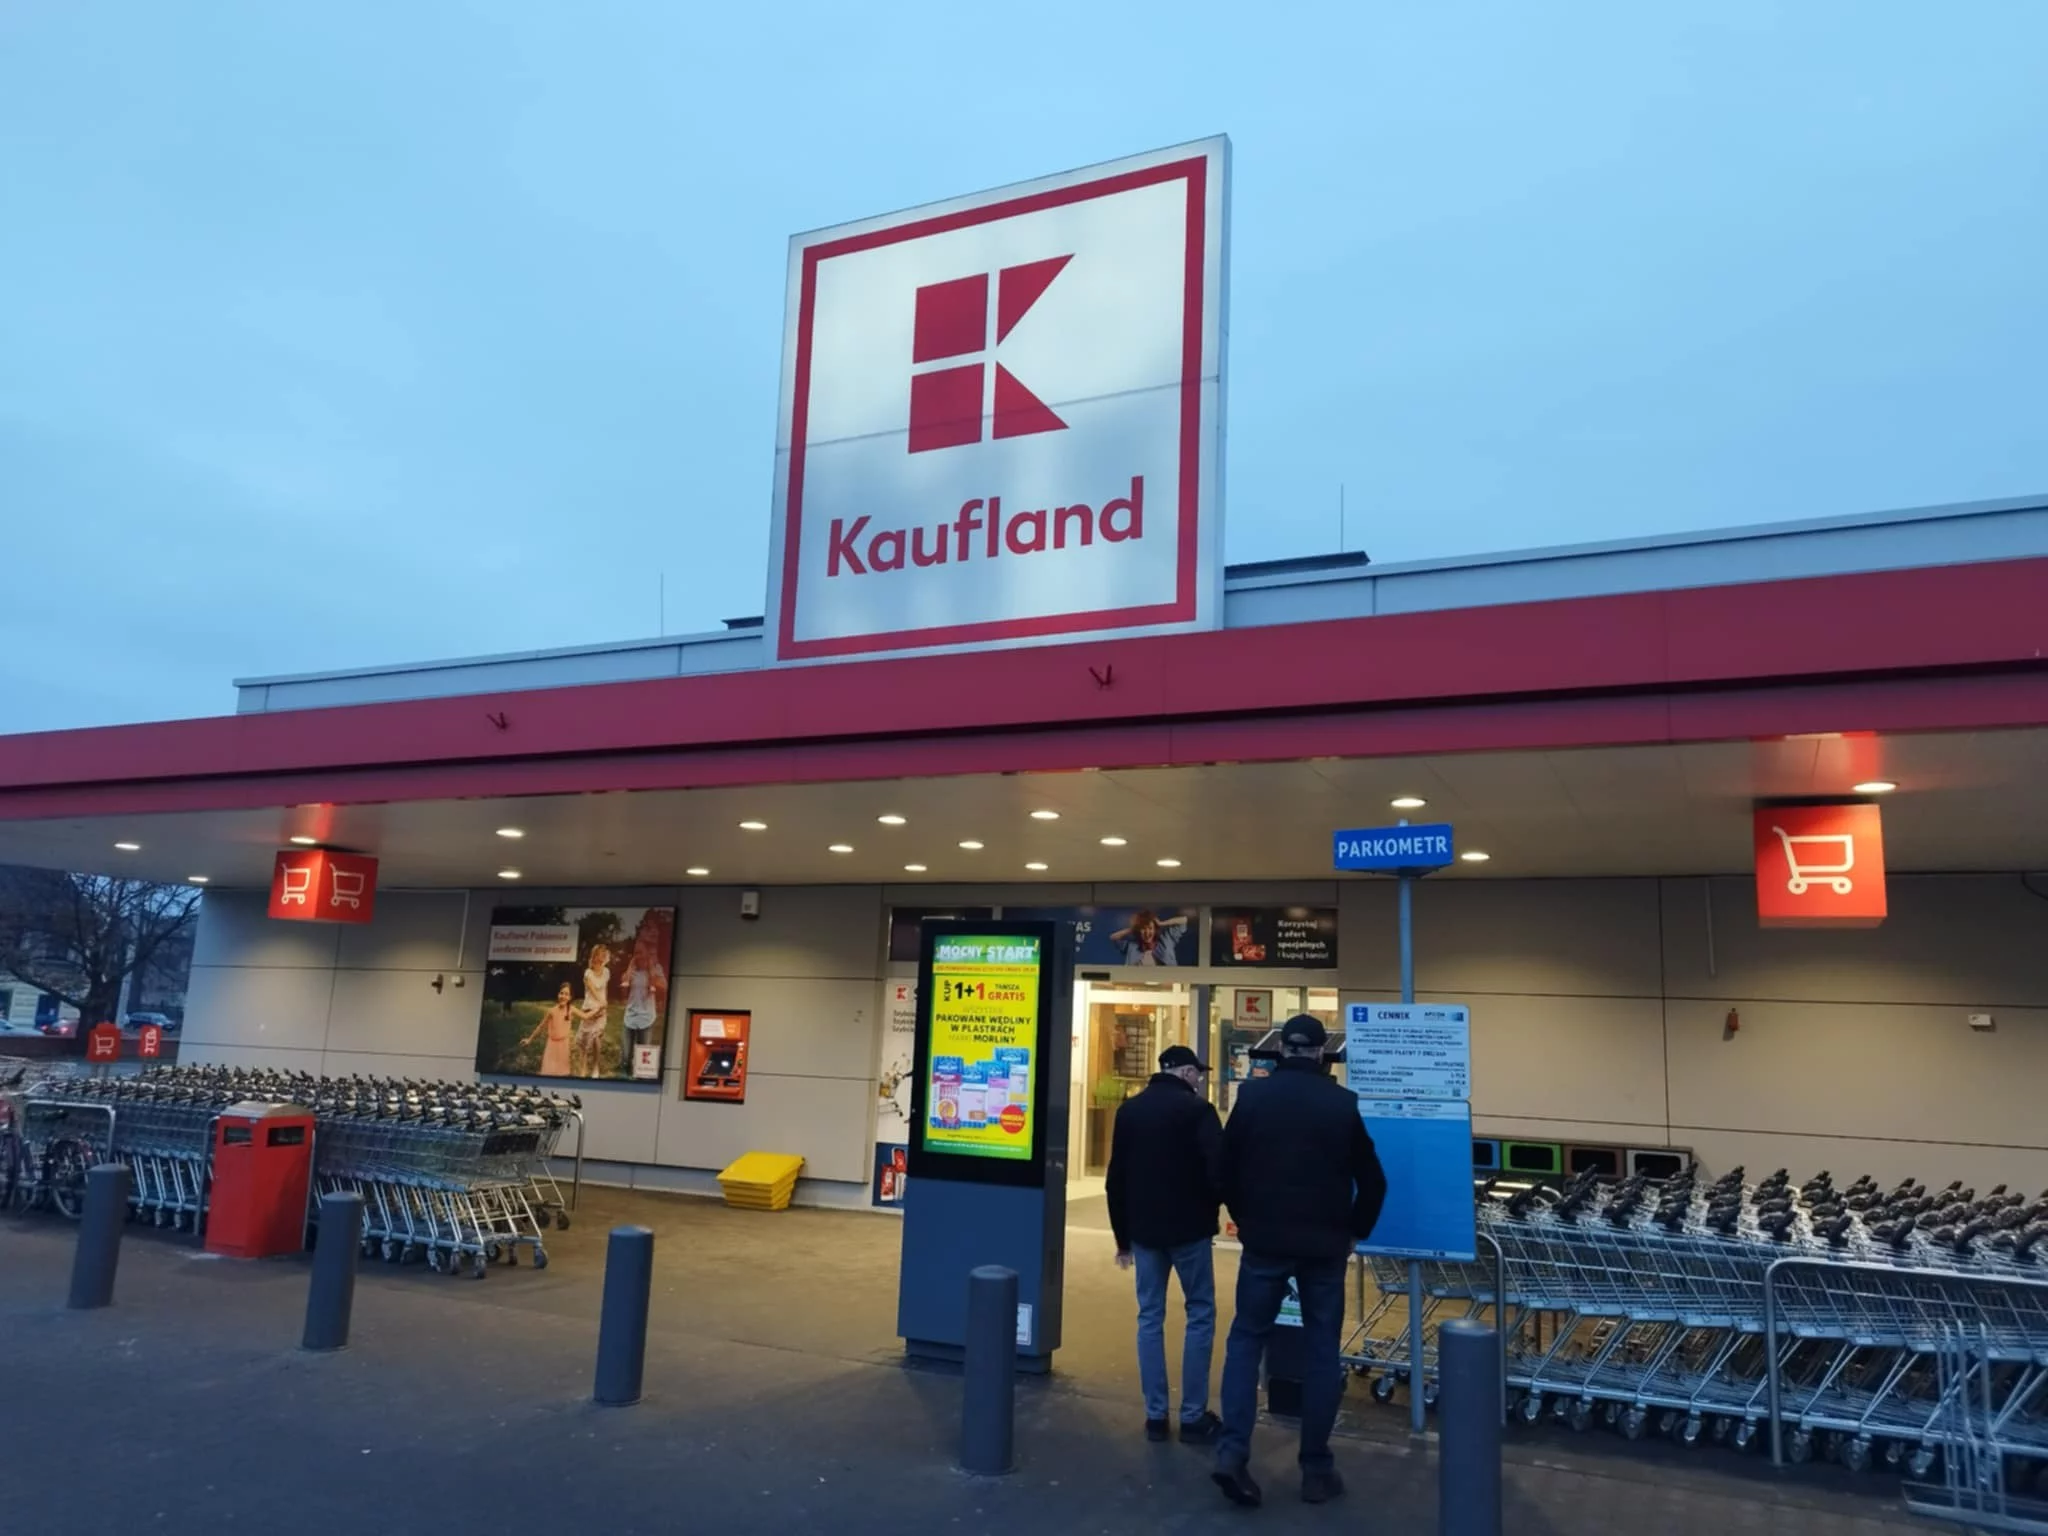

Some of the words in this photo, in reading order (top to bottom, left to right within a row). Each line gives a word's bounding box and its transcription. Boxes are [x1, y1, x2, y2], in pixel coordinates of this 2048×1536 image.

[827, 475, 1144, 577] Kaufland
[1338, 835, 1448, 858] PARKOMETR
[939, 944, 983, 960] MOCNY
[987, 945, 1034, 962] START
[943, 980, 951, 1001] KUP
[987, 991, 1025, 1002] GRATIS
[935, 1013, 985, 1023] PAKOWANE
[1377, 1011, 1410, 1020] CENNIK
[961, 1025, 1015, 1035] PLASTRACH
[973, 1034, 1017, 1045] MORLINY
